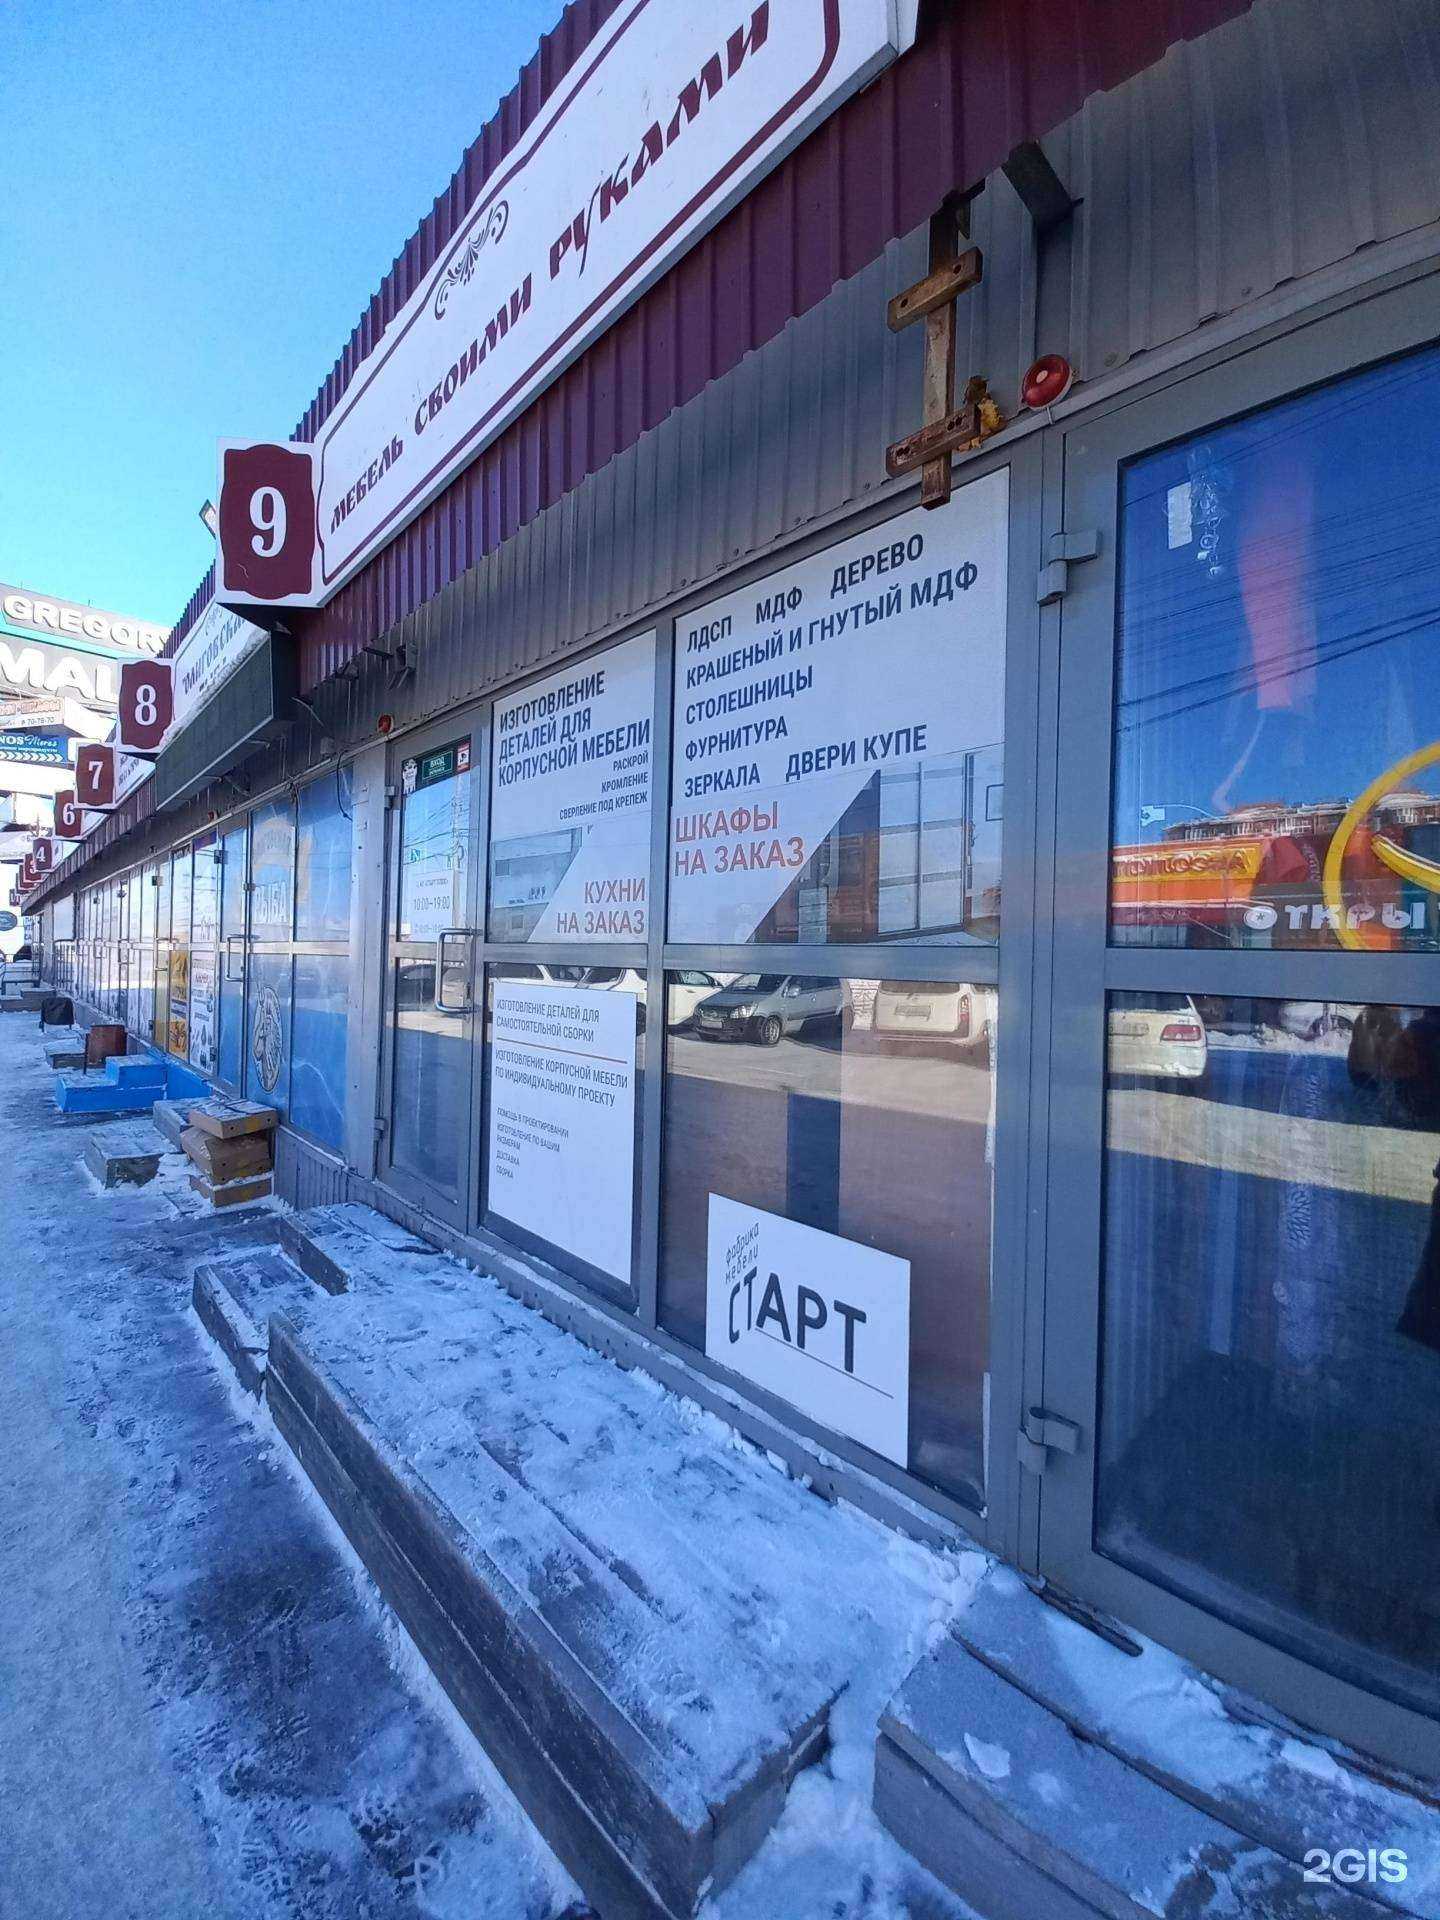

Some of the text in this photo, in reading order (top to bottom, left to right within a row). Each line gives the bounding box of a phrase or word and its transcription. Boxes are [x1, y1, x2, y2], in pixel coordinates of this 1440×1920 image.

[330, 0, 770, 535] МЕБЕЛЬ СВОИМИ РУКАМИ
[249, 486, 287, 558] 9
[687, 533, 925, 653] ЛДСП МДФ ДЕРЕВО
[686, 560, 979, 689] КРАШЕНЫЙ И ГНУТЫЙ МДФ
[135, 684, 157, 725] 8
[500, 670, 606, 734] ИЗГОТОВЛЕНИЕ
[685, 665, 814, 725] СТОЛЕШНИЦЫ
[498, 707, 592, 766] ДЕТАЛЕЙ ДЛЯ
[498, 718, 651, 788] КОРПУСНОЙ МЕБЕЛИ
[685, 715, 789, 763] ФУРНИТУРА
[88, 760, 104, 783] 7
[612, 749, 649, 772] РАСКРОЙ
[684, 724, 928, 799] ЗЕРКАЛА ДВЕРИ КУПЕ
[601, 771, 649, 794] КРОМЛЕНИЕ
[62, 802, 75, 826] 6
[559, 790, 648, 821] СВЕРЛЕНИЕ ПОД КРЕПЕЖ
[674, 801, 779, 844] ШКАФЫ
[36, 846, 46, 863] 4
[674, 836, 806, 877] НА ЗАКАЗ
[583, 877, 646, 904] КУХНИ
[556, 908, 644, 935] НА ЗАКАЗ
[1243, 902, 1440, 930] ОТКРЫ
[496, 999, 600, 1023] ИЗГОТОВЛЕНИЕ ДЕТАЛЕЙ ДЛЯ
[496, 1015, 594, 1042] САМОСТОЯТЕЛЬНОЙ СБОРКИ
[495, 1049, 628, 1089] ИЗГОТОВЛЕНИЕ КОРПУСНОЙ МЕБЕЛИ
[505, 1067, 577, 1097] ИНДИВИДУАЛЬНОМУ
[578, 1086, 616, 1107] ПРОЕКТУ
[725, 1222, 760, 1266] фабрика
[725, 1244, 759, 1284] мебели
[728, 1266, 867, 1374] СТАРТ
